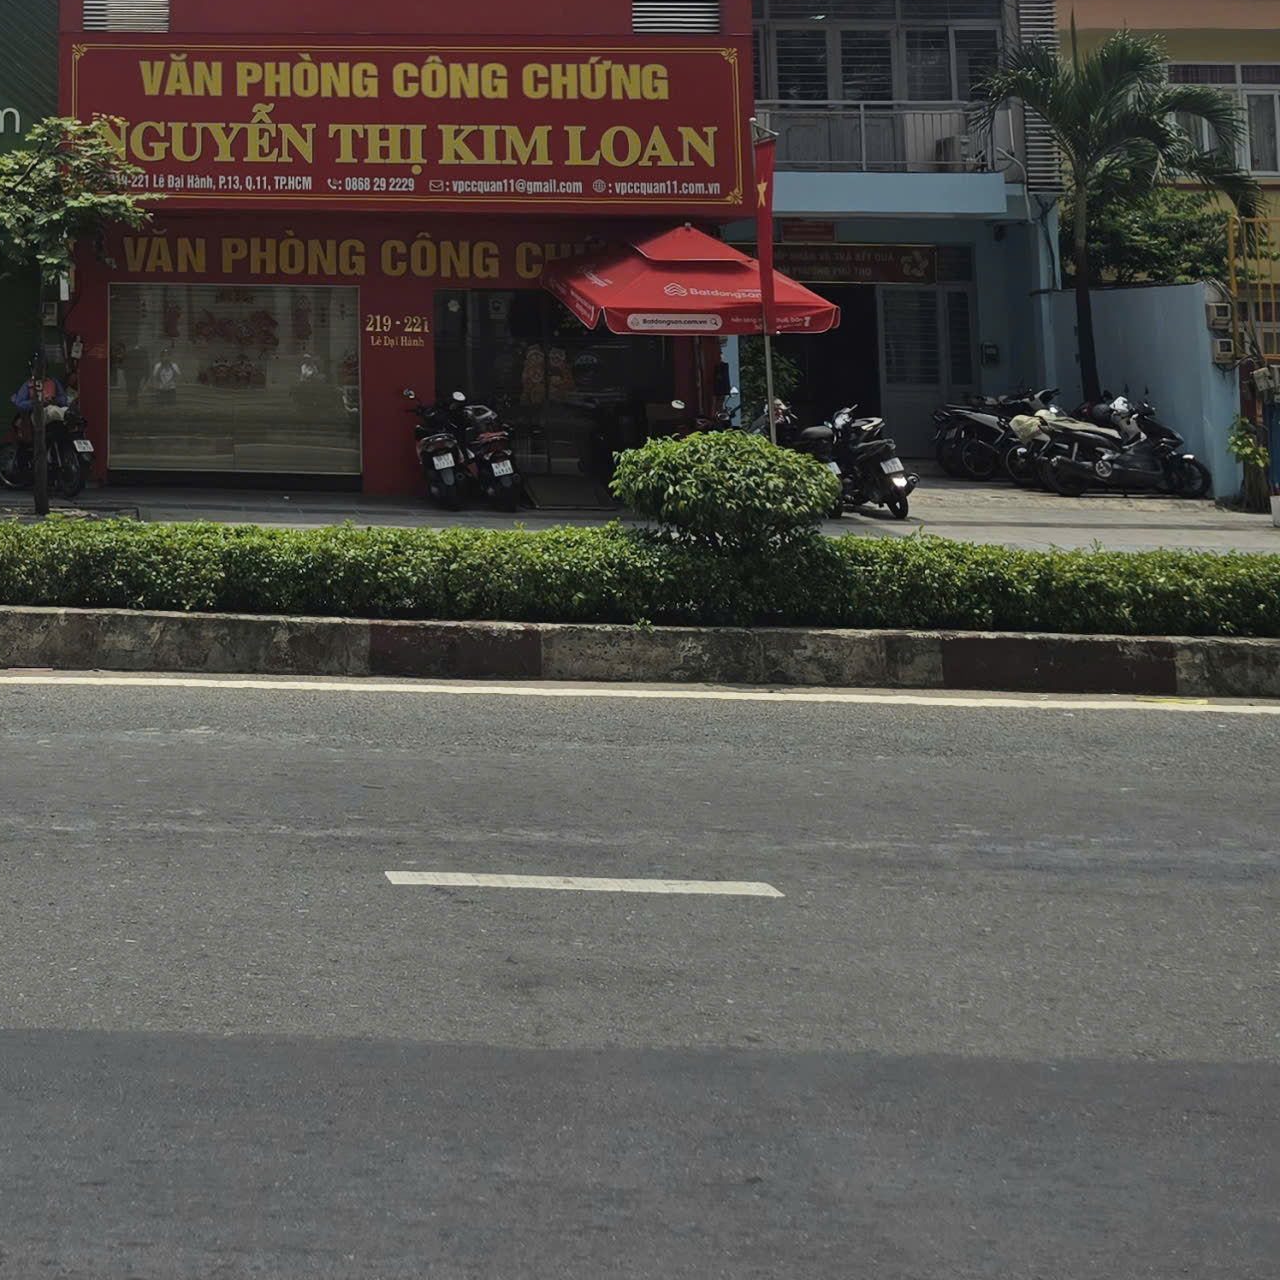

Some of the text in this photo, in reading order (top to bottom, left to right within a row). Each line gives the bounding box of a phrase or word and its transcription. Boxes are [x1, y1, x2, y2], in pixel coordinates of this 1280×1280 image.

[139, 52, 669, 101] VĂN PHÒNG CÔNG CHỨNG
[103, 103, 719, 175] NGUYỄN THỊ KIM LOAN
[153, 174, 165, 188] Lê
[167, 174, 184, 191] Đại
[186, 174, 216, 190] Hành,
[219, 176, 242, 191] P.13,
[245, 176, 270, 191] Q.11,
[274, 176, 312, 191] TP.HCM
[345, 177, 371, 191] 0868
[373, 177, 387, 191] 29
[389, 178, 415, 192] 2229
[452, 179, 583, 195] vpccquan11@gmail.com
[615, 180, 720, 196] vpccquan11.com.vn
[123, 230, 207, 273] VĂN
[221, 230, 368, 276] PHÒNG
[380, 232, 501, 279] CÔNG
[366, 314, 392, 332] 219
[404, 315, 430, 333] 221
